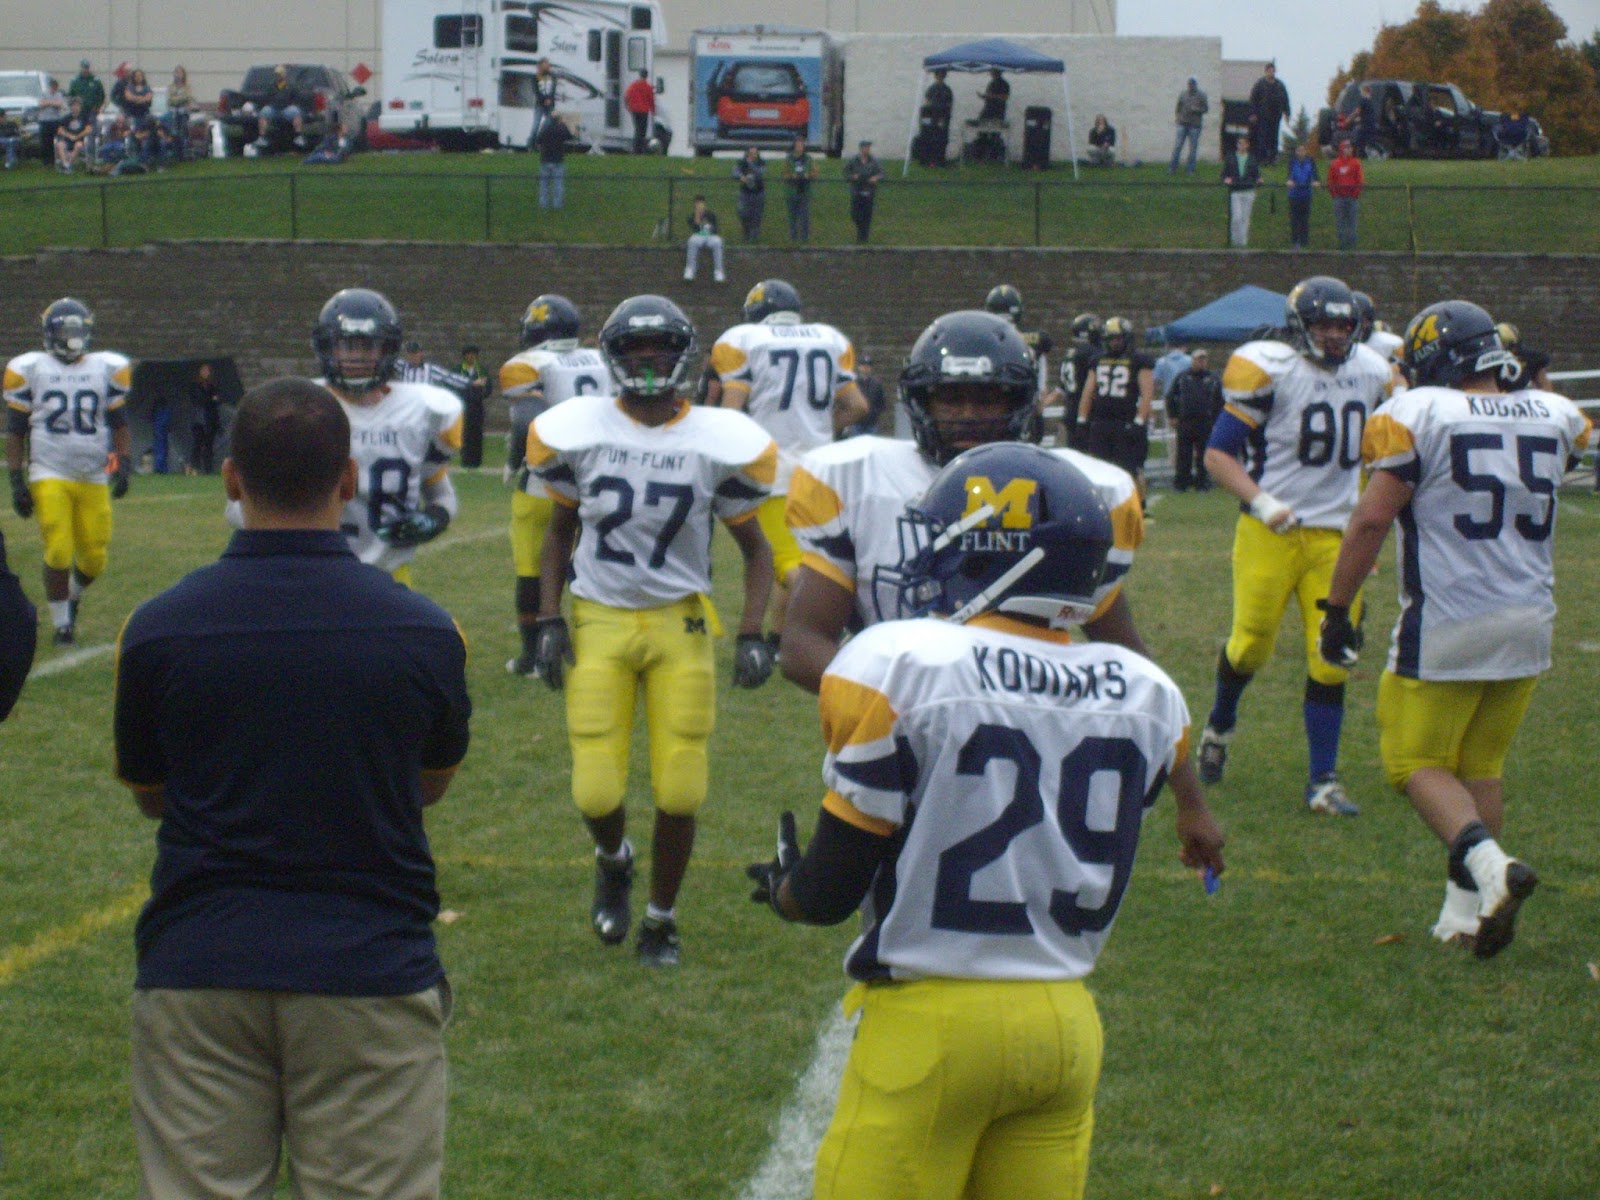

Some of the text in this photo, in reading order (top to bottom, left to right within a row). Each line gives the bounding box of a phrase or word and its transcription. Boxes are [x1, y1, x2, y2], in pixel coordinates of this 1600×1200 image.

[768, 348, 833, 411] 70
[1096, 364, 1129, 397] 52
[607, 449, 687, 472] UM-FLINT
[1299, 401, 1366, 470] 80
[961, 476, 1038, 530] M
[1450, 432, 1559, 542] 55
[588, 474, 695, 570] 27
[959, 532, 1033, 552] FLINT
[683, 616, 707, 636] M
[971, 644, 1127, 701] KODIAKS
[930, 723, 1148, 937] 29
